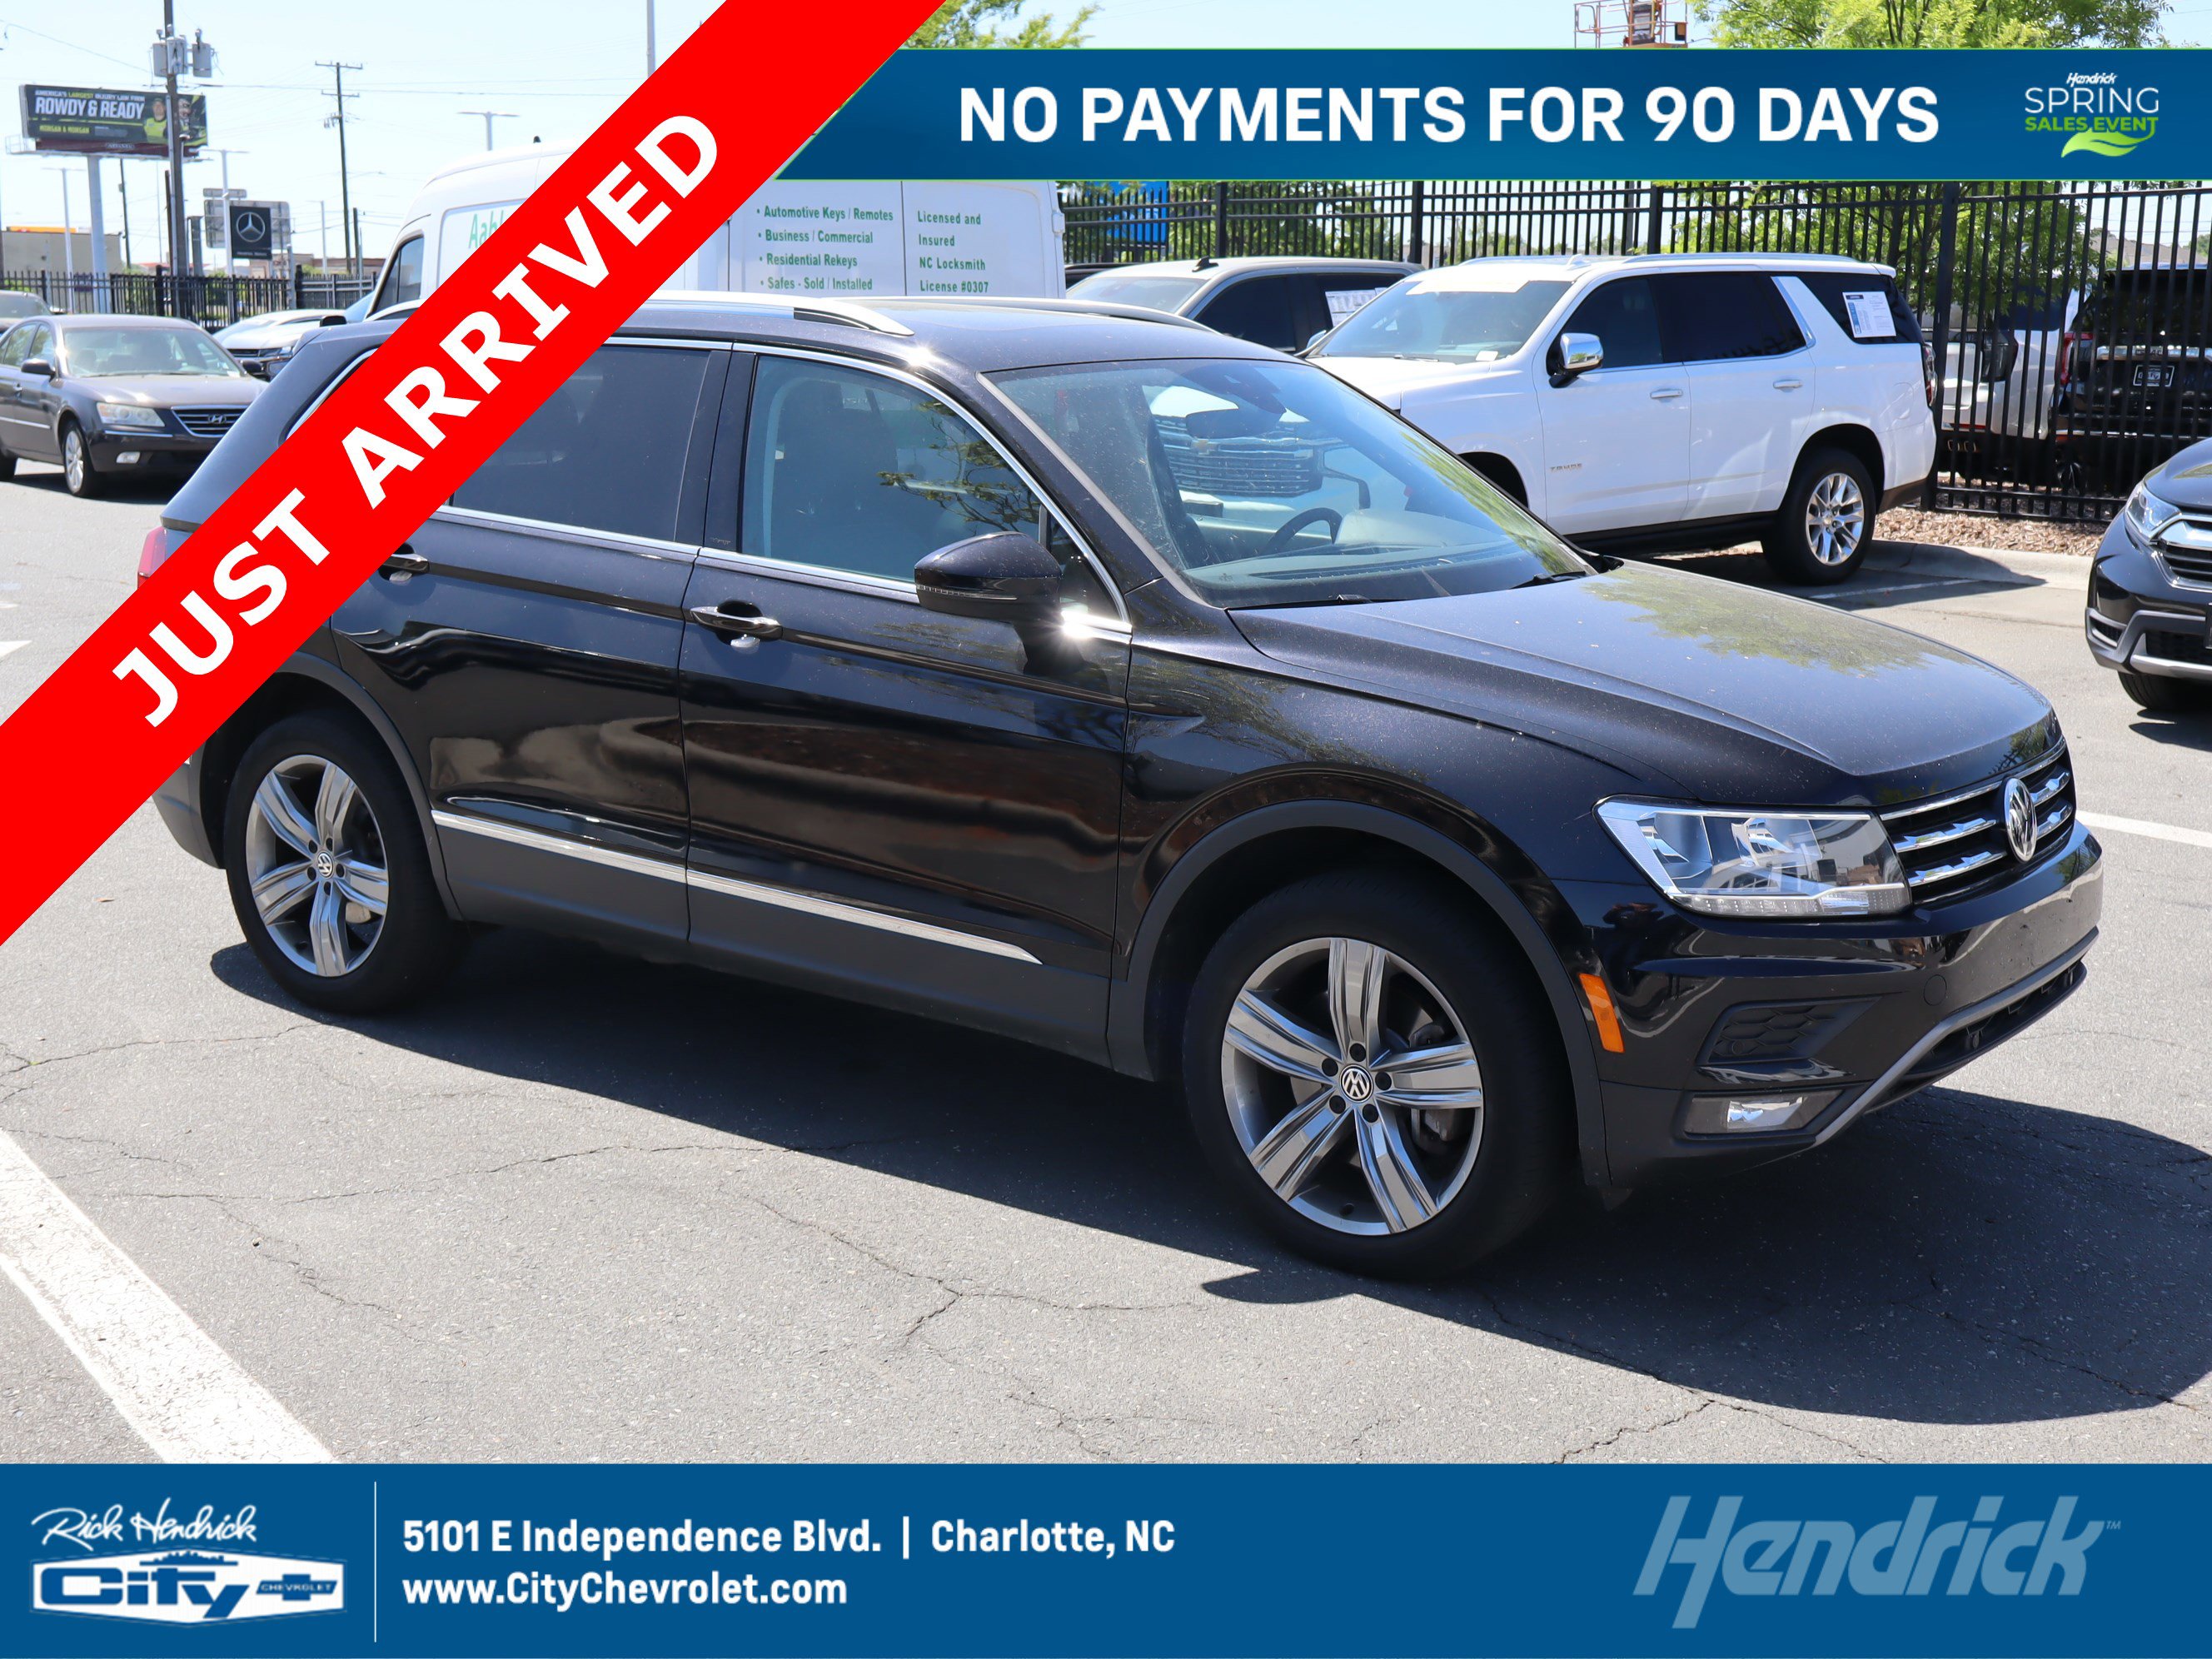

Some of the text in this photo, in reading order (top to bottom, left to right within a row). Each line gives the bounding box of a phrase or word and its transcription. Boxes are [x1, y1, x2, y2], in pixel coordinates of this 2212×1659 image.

[35, 97, 145, 119] ROWDY & READY
[764, 206, 820, 219] Automotive
[823, 207, 845, 222] Keys
[854, 207, 894, 222] Remotes
[917, 211, 981, 225] Licensed and
[765, 229, 810, 242] Business
[818, 230, 873, 243] Commercial
[919, 234, 955, 247] Insured
[766, 253, 858, 269] Residential Rekeys
[919, 257, 986, 271] NC Locksmith
[767, 276, 795, 290] Safes
[804, 276, 825, 290] Sold
[833, 277, 873, 291] Installed
[919, 280, 989, 293] License #0307
